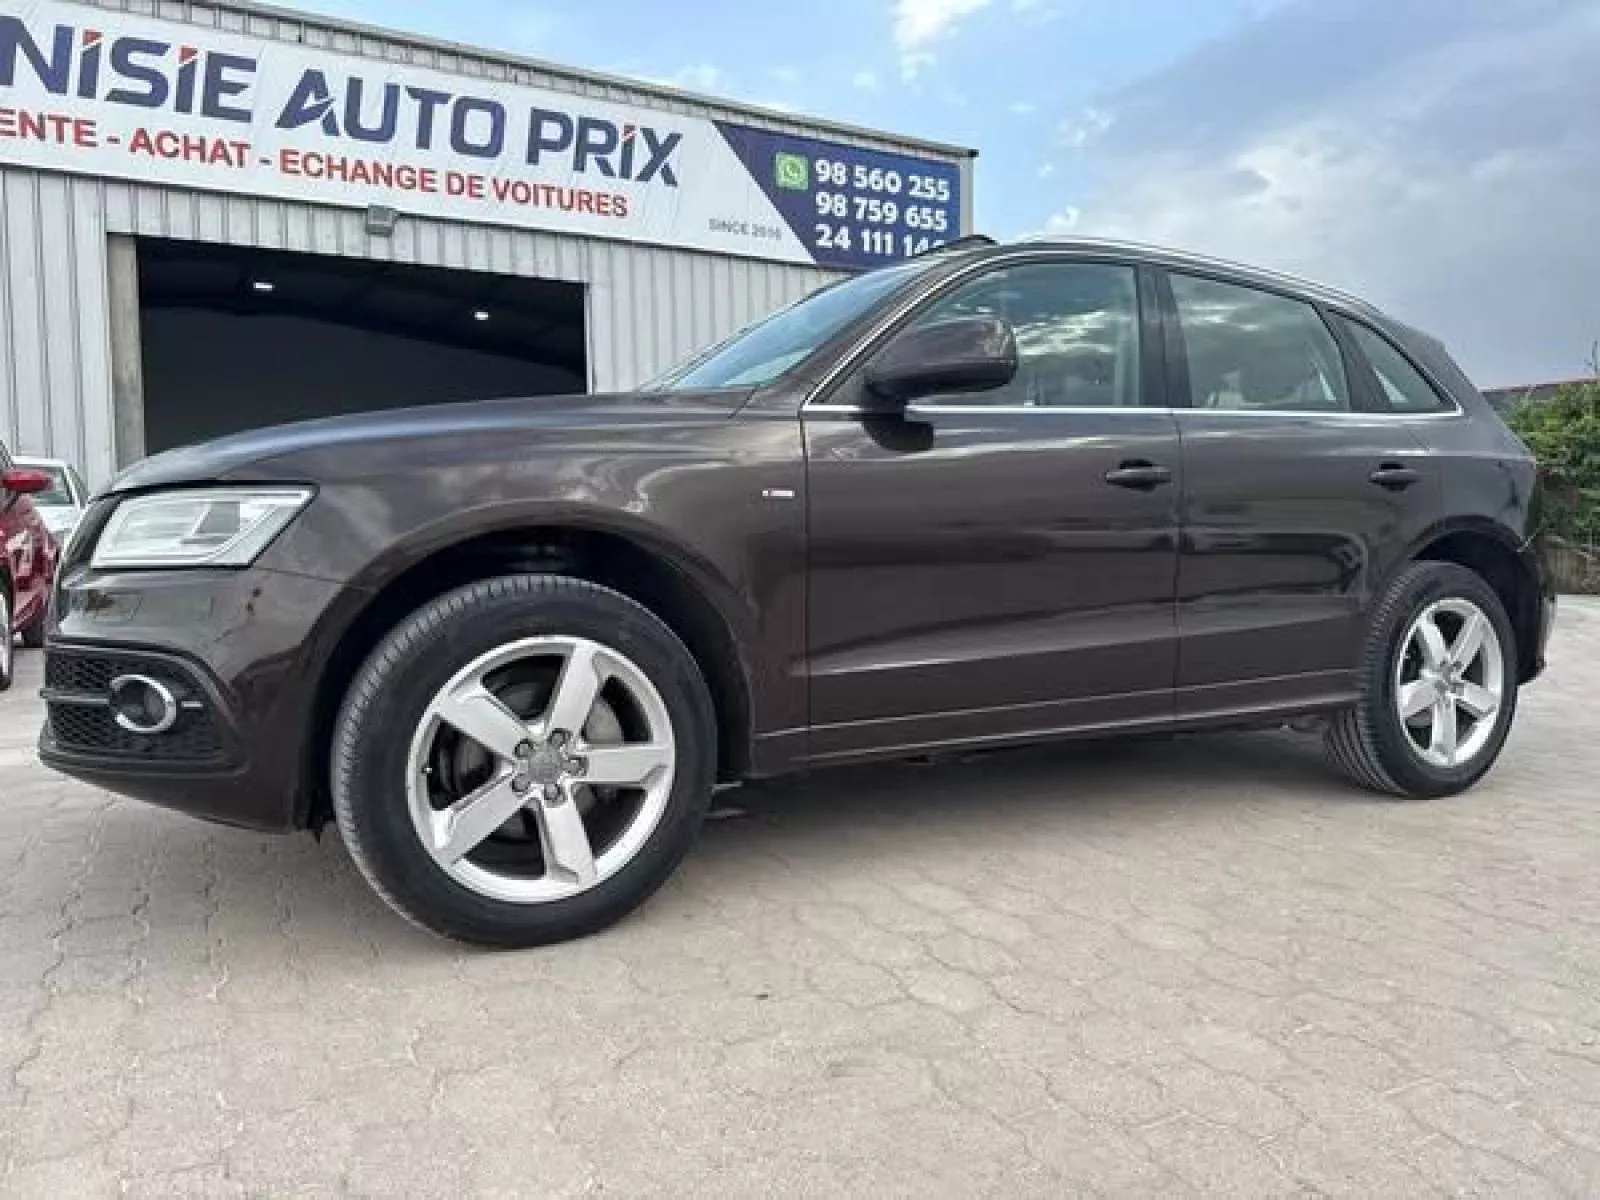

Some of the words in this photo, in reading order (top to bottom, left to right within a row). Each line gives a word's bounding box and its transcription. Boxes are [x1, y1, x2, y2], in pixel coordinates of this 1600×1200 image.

[274, 68, 507, 158] AUTO
[0, 107, 98, 148] ENTE
[129, 127, 251, 168] ACHAT
[279, 148, 438, 193] ECHANGE
[445, 170, 486, 200] DE
[493, 178, 628, 218] VOITURES
[815, 159, 847, 186] 98
[852, 164, 901, 195] 560
[907, 175, 950, 202] 255
[815, 191, 848, 217] 98
[852, 196, 898, 225] 759
[904, 205, 948, 232] 655
[815, 223, 851, 251] 24
[860, 229, 894, 256] 111
